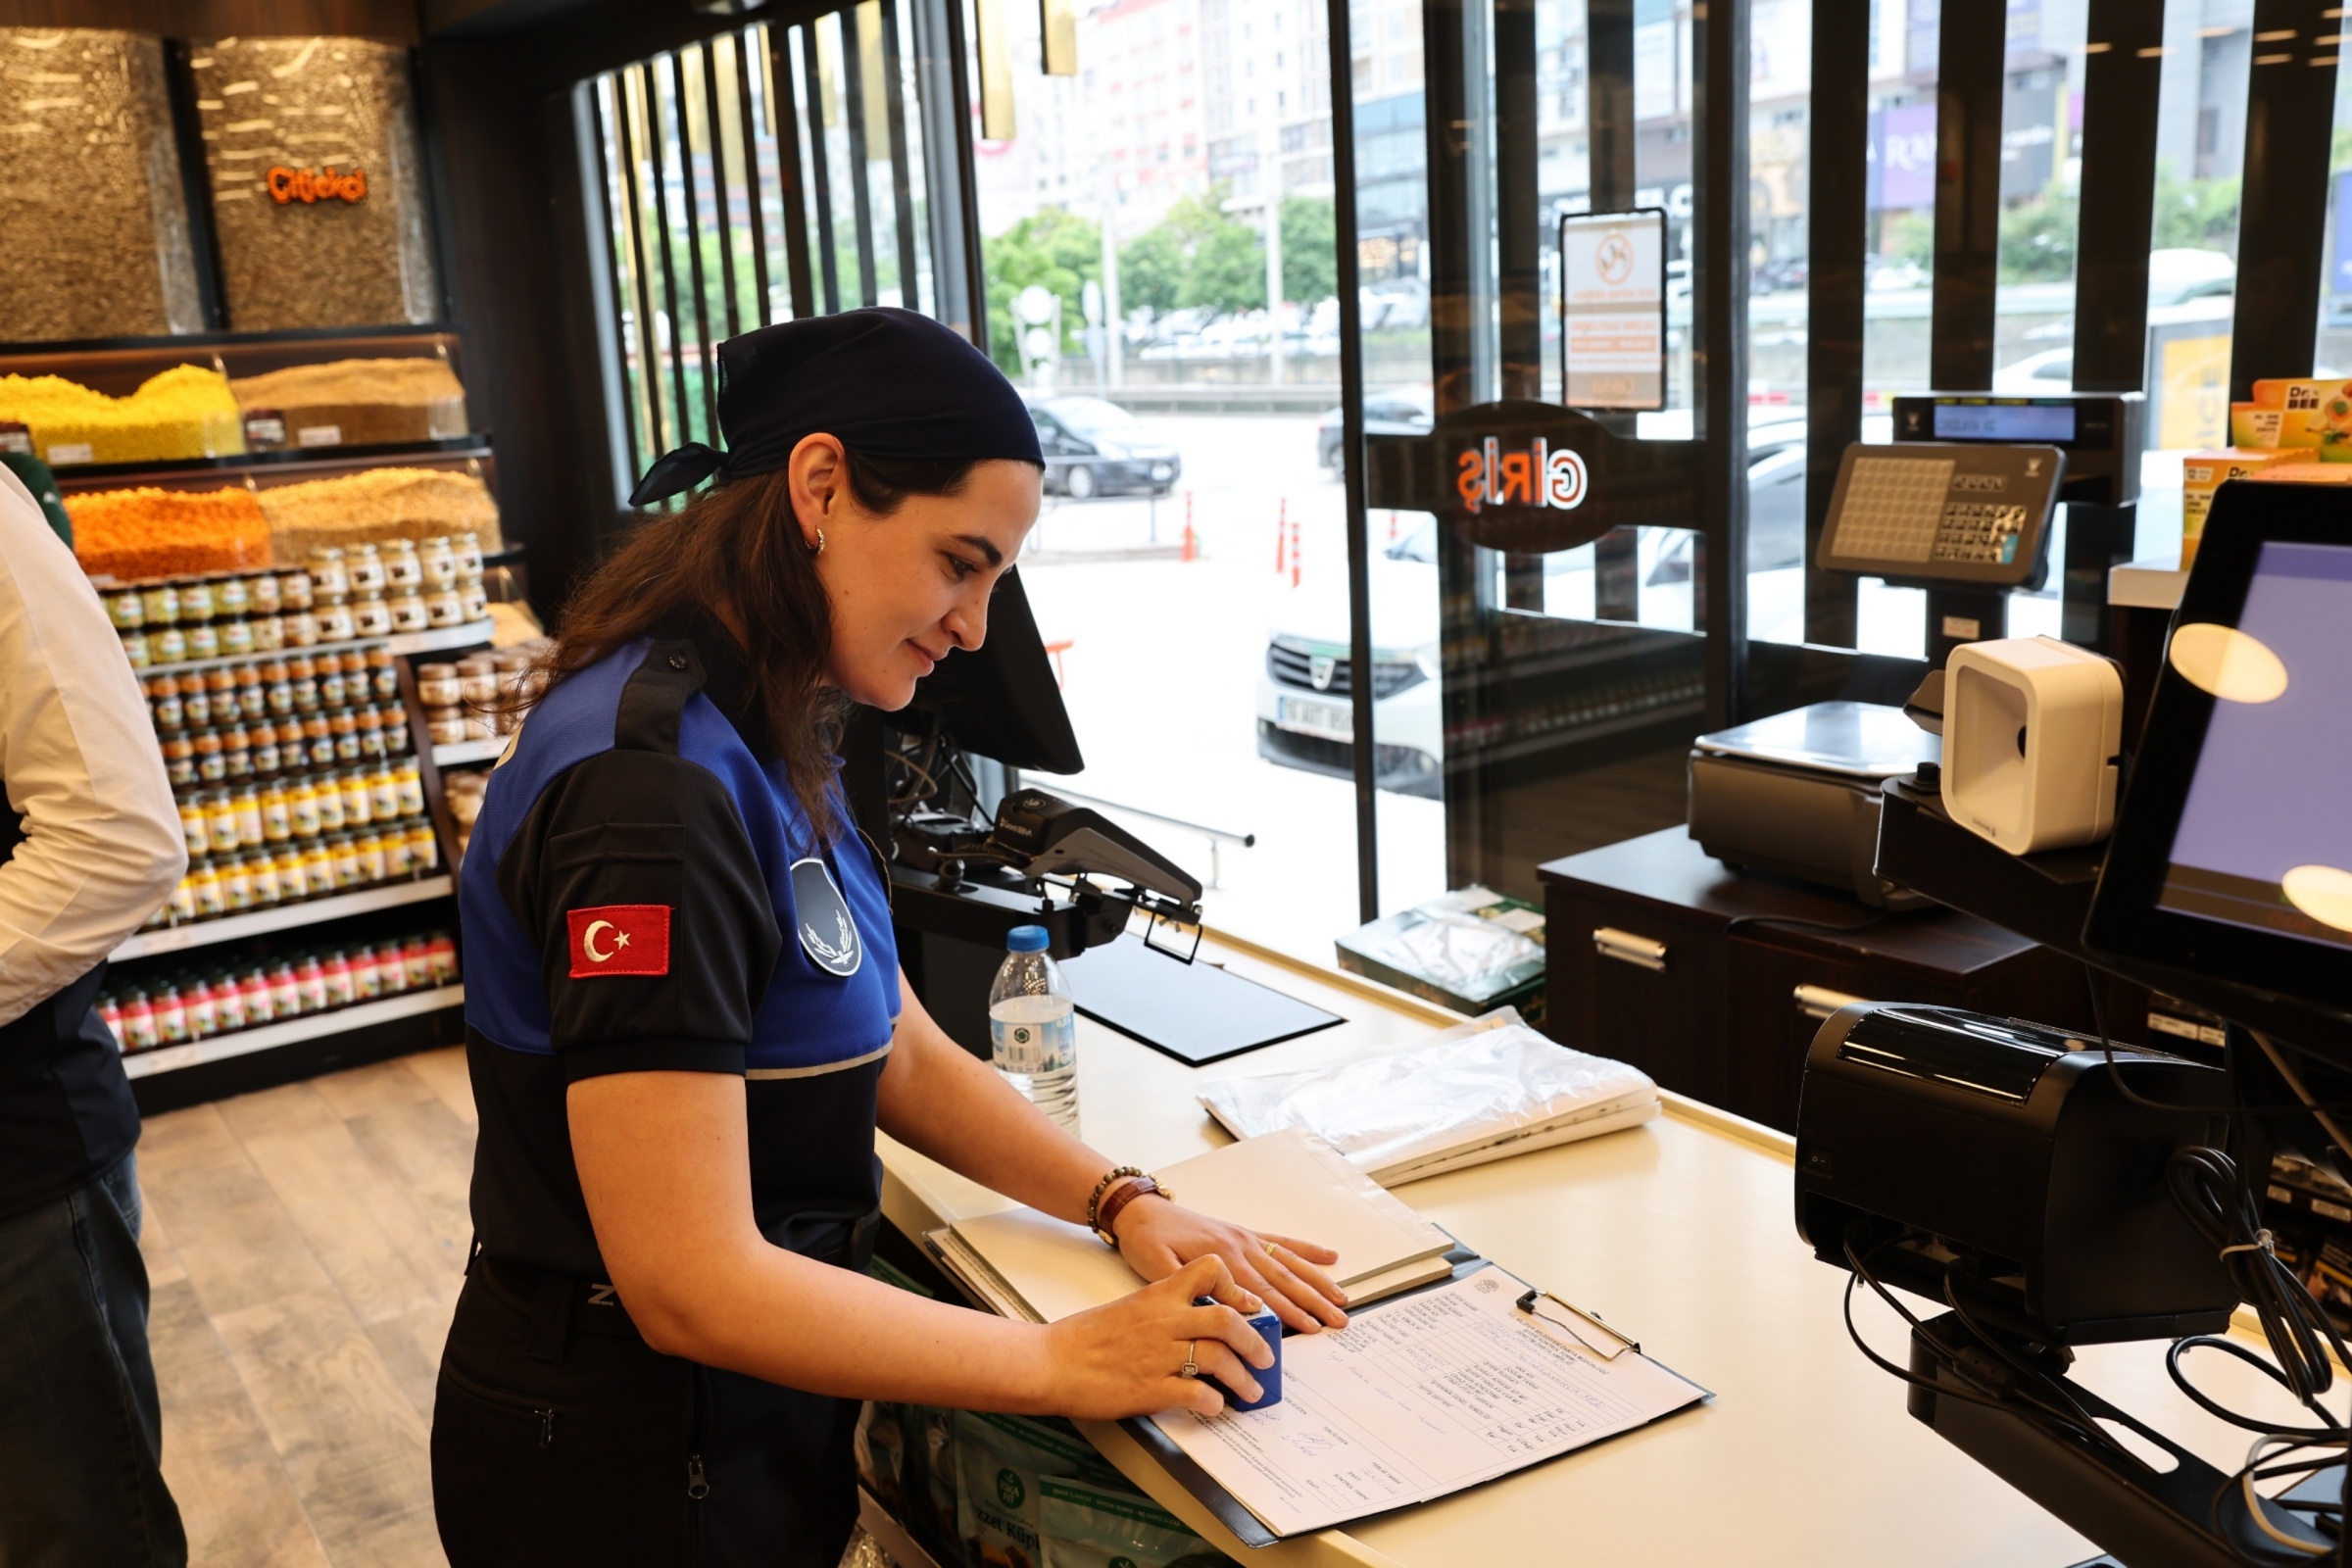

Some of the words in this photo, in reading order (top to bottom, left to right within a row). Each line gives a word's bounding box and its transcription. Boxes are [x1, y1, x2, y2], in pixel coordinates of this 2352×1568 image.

[2287, 398, 2320, 410] BEE
[588, 1283, 616, 1306] N
[1534, 1329, 1562, 1347] BELEDİYESİ
[1559, 1345, 1578, 1356] ZABITA
[1534, 1342, 1552, 1353] ZABITA
[1538, 1338, 1559, 1352] KONTROL
[1005, 1521, 1041, 1551] Küpl
